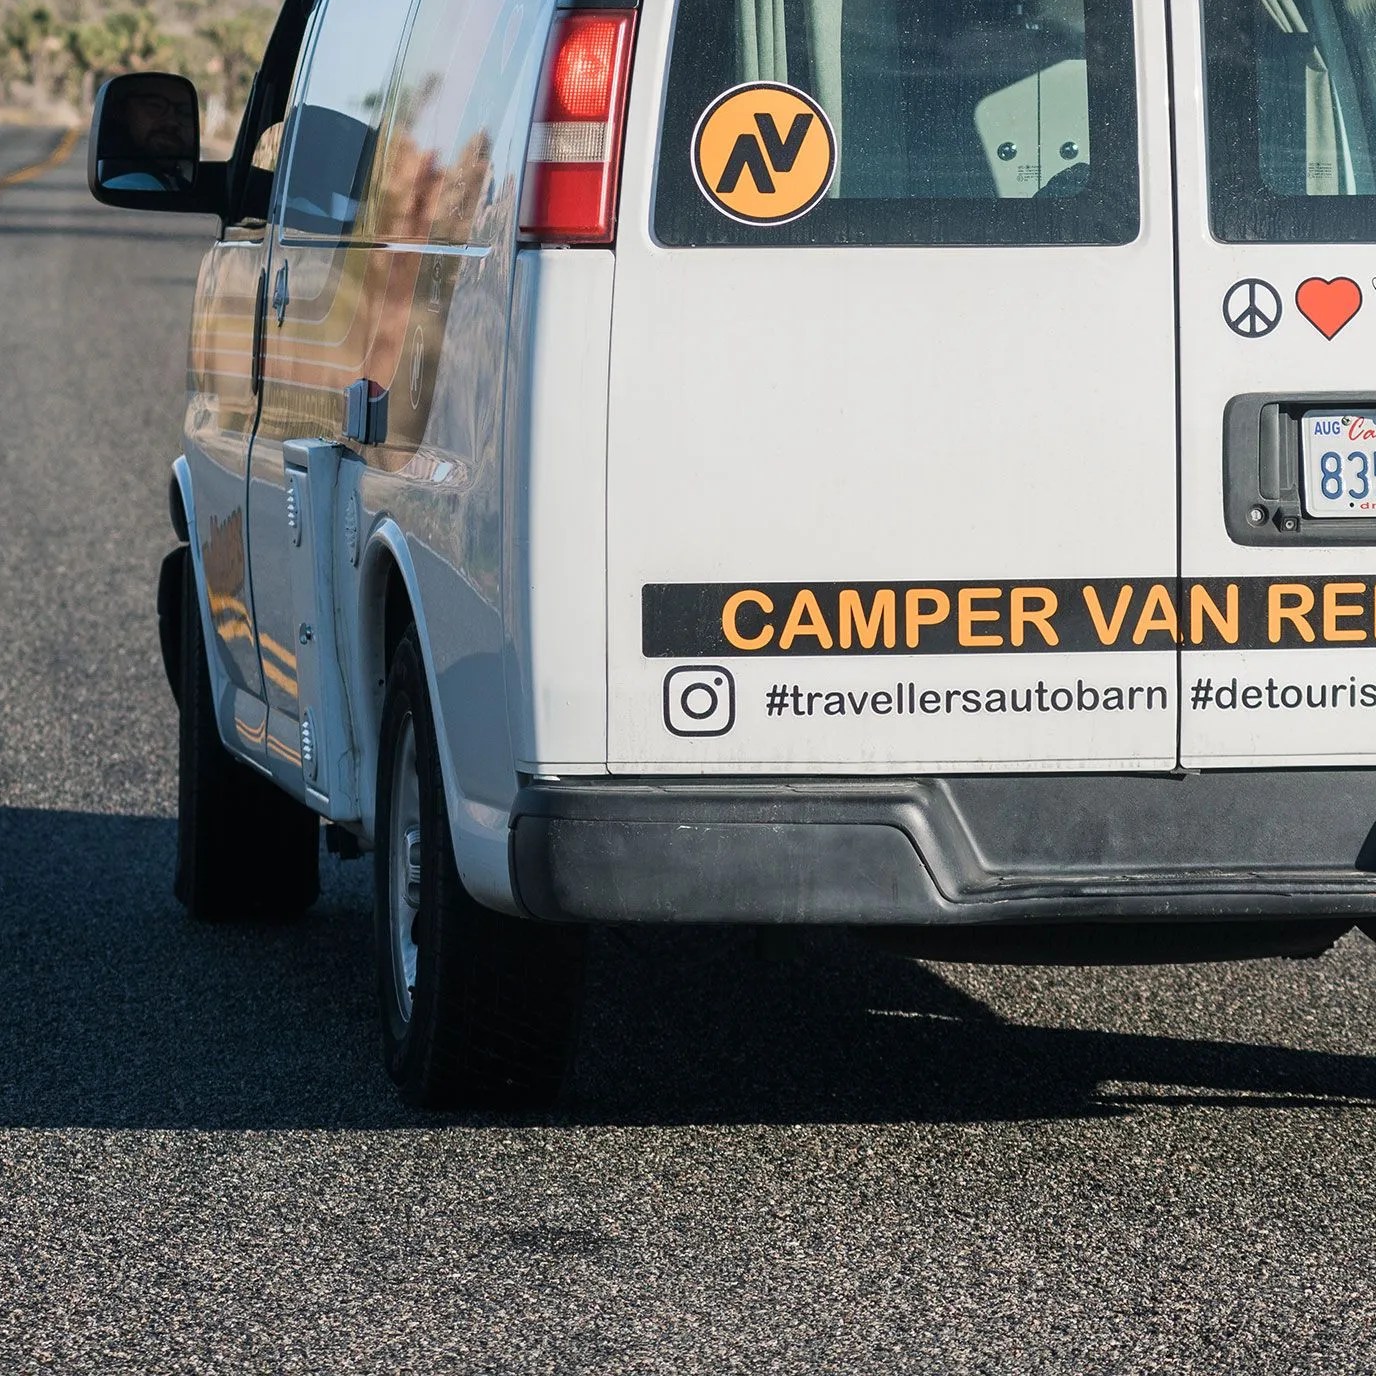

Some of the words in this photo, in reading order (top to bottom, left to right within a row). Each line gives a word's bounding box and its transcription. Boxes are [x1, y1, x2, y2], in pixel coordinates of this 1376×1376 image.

[1313, 420, 1341, 436] AUG
[721, 586, 1060, 651] CAMPER
[1082, 582, 1240, 646] VAN
[765, 679, 1168, 717] #travellersautobarn
